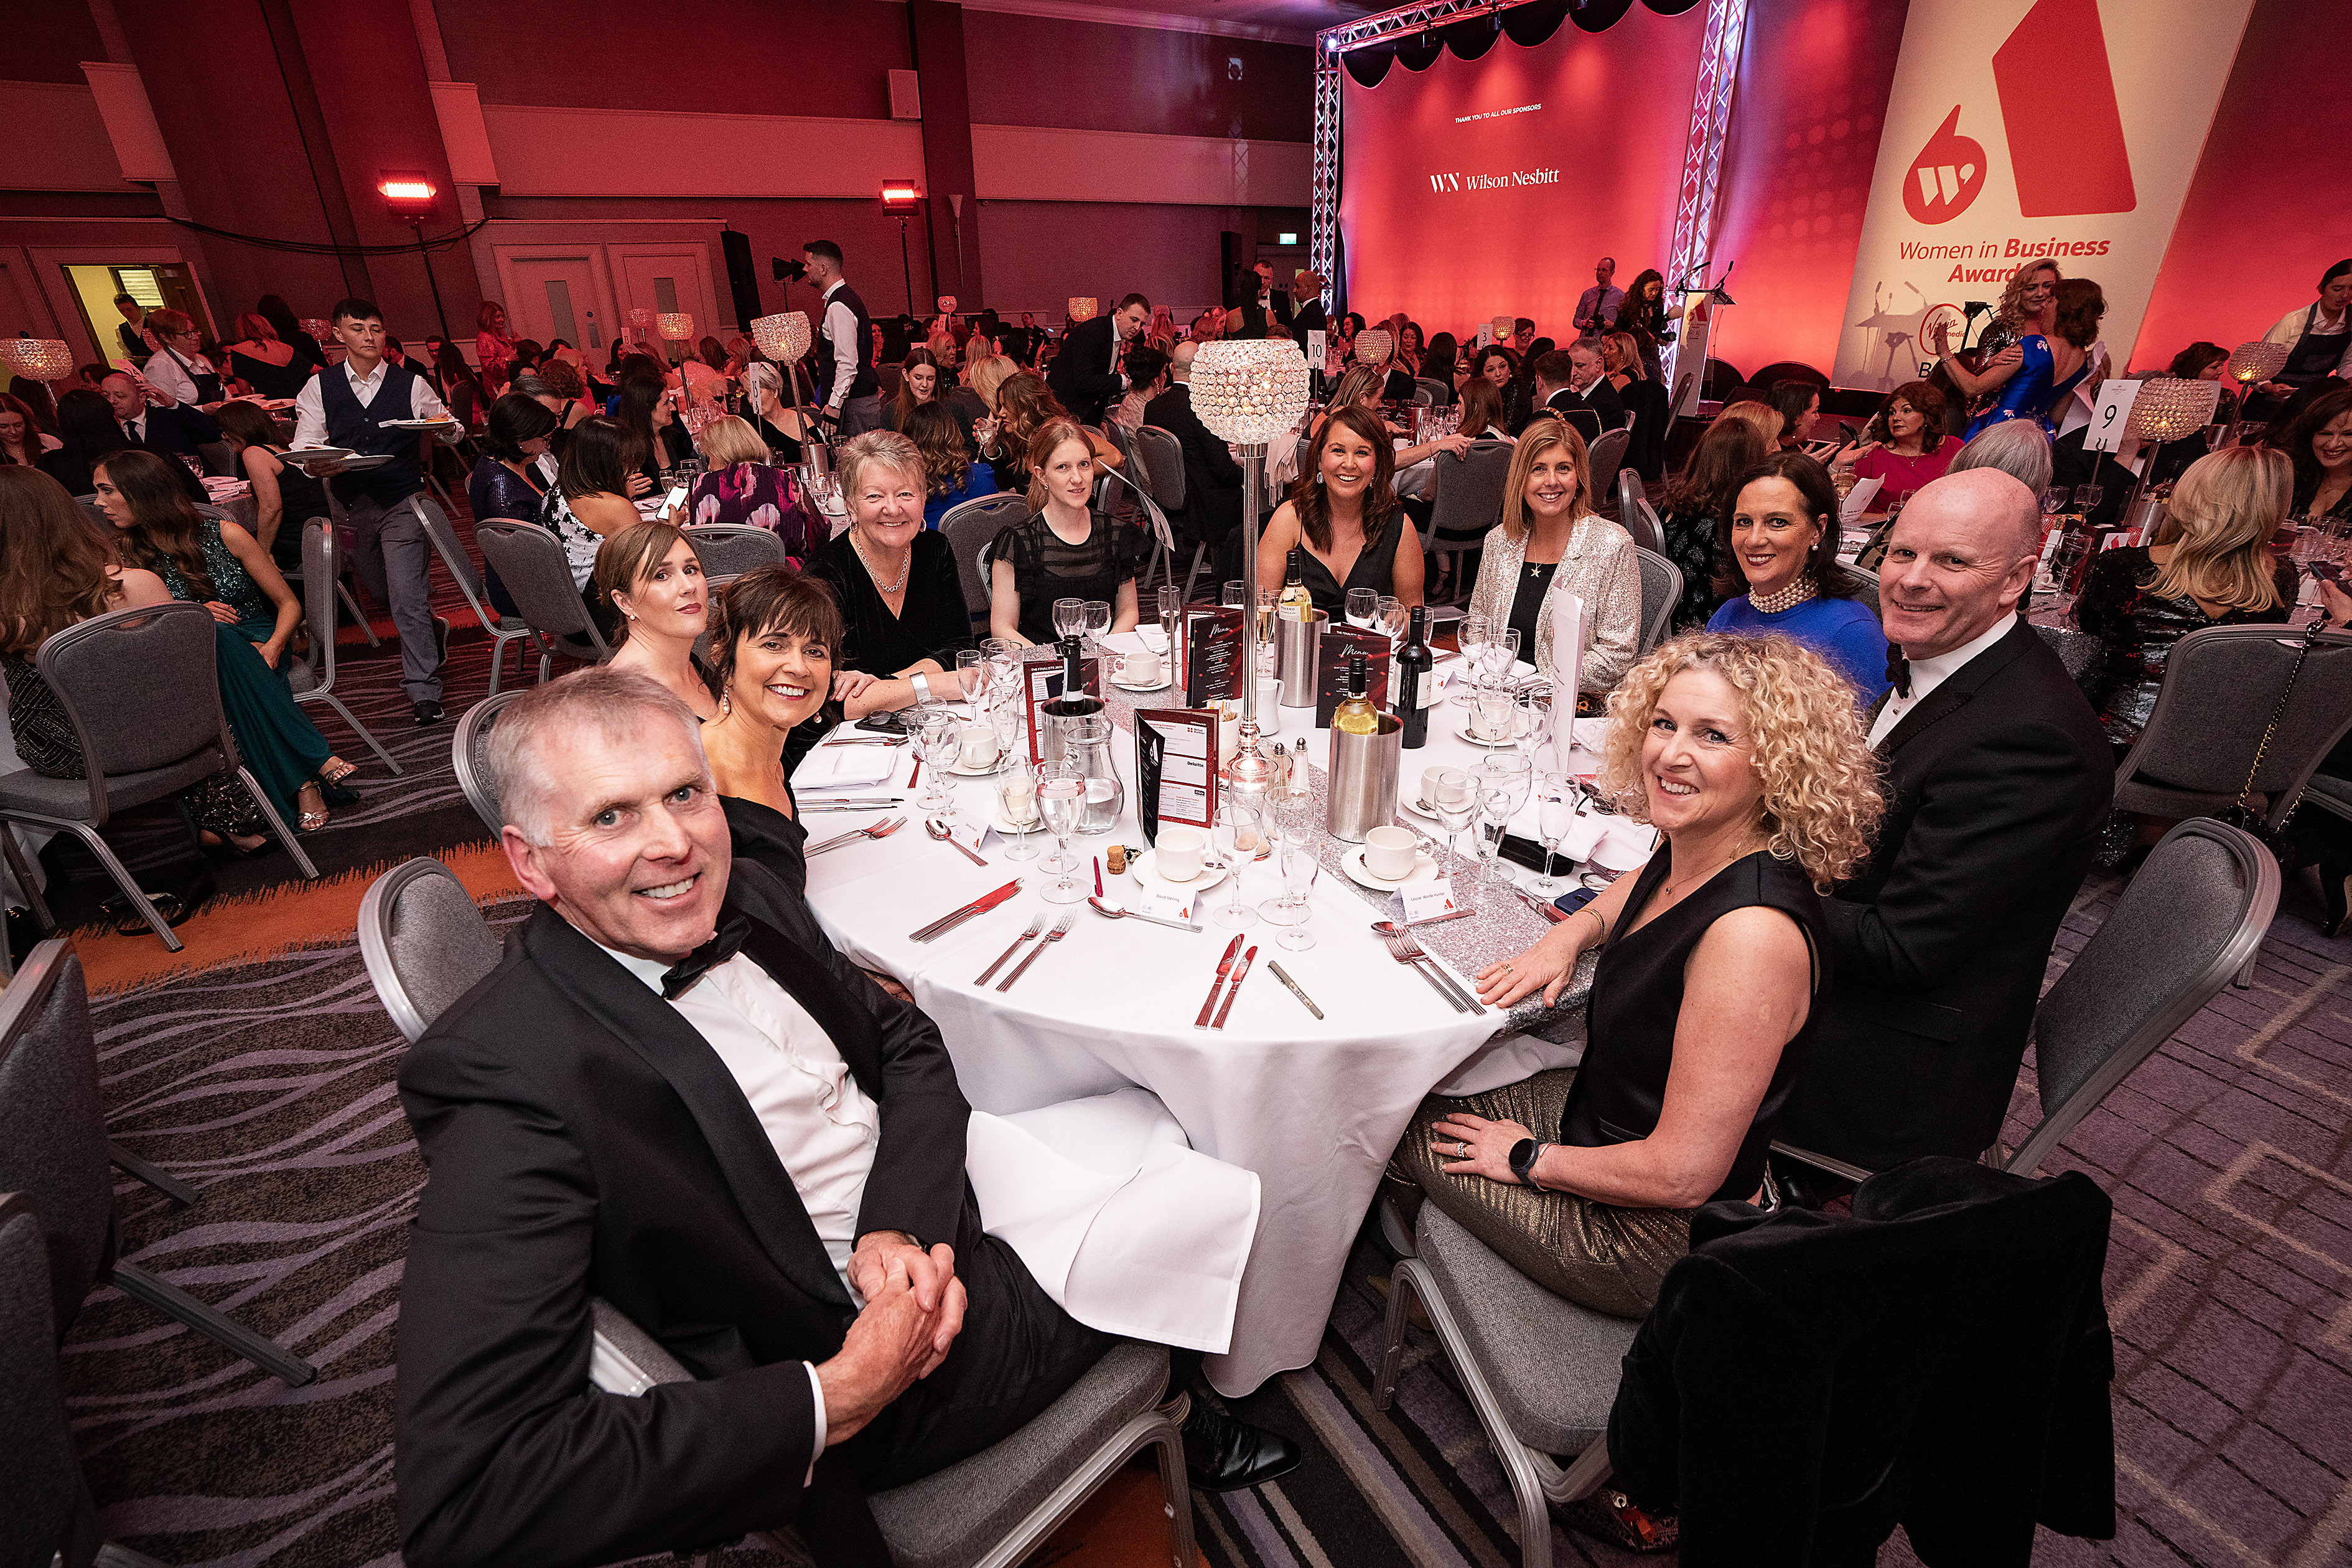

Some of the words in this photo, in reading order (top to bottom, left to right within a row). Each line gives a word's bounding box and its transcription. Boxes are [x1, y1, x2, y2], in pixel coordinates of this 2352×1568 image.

[1513, 103, 1541, 114] SPONSORS
[1430, 172, 1460, 193] WN
[1466, 174, 1509, 190] Wilson
[1511, 168, 1560, 187] Nesbitt
[1900, 241, 1973, 259] Women
[1979, 240, 1998, 259] in
[2004, 237, 2111, 258] Business
[1948, 263, 2022, 283] Award
[1926, 313, 1958, 340] Viin
[1483, 332, 1487, 342] 3
[1312, 344, 1322, 358] 10
[124, 368, 141, 378] 24
[752, 380, 758, 398] 15
[2101, 404, 2117, 429] 9
[1209, 623, 1230, 638] Menu
[1340, 643, 1369, 658] Menu
